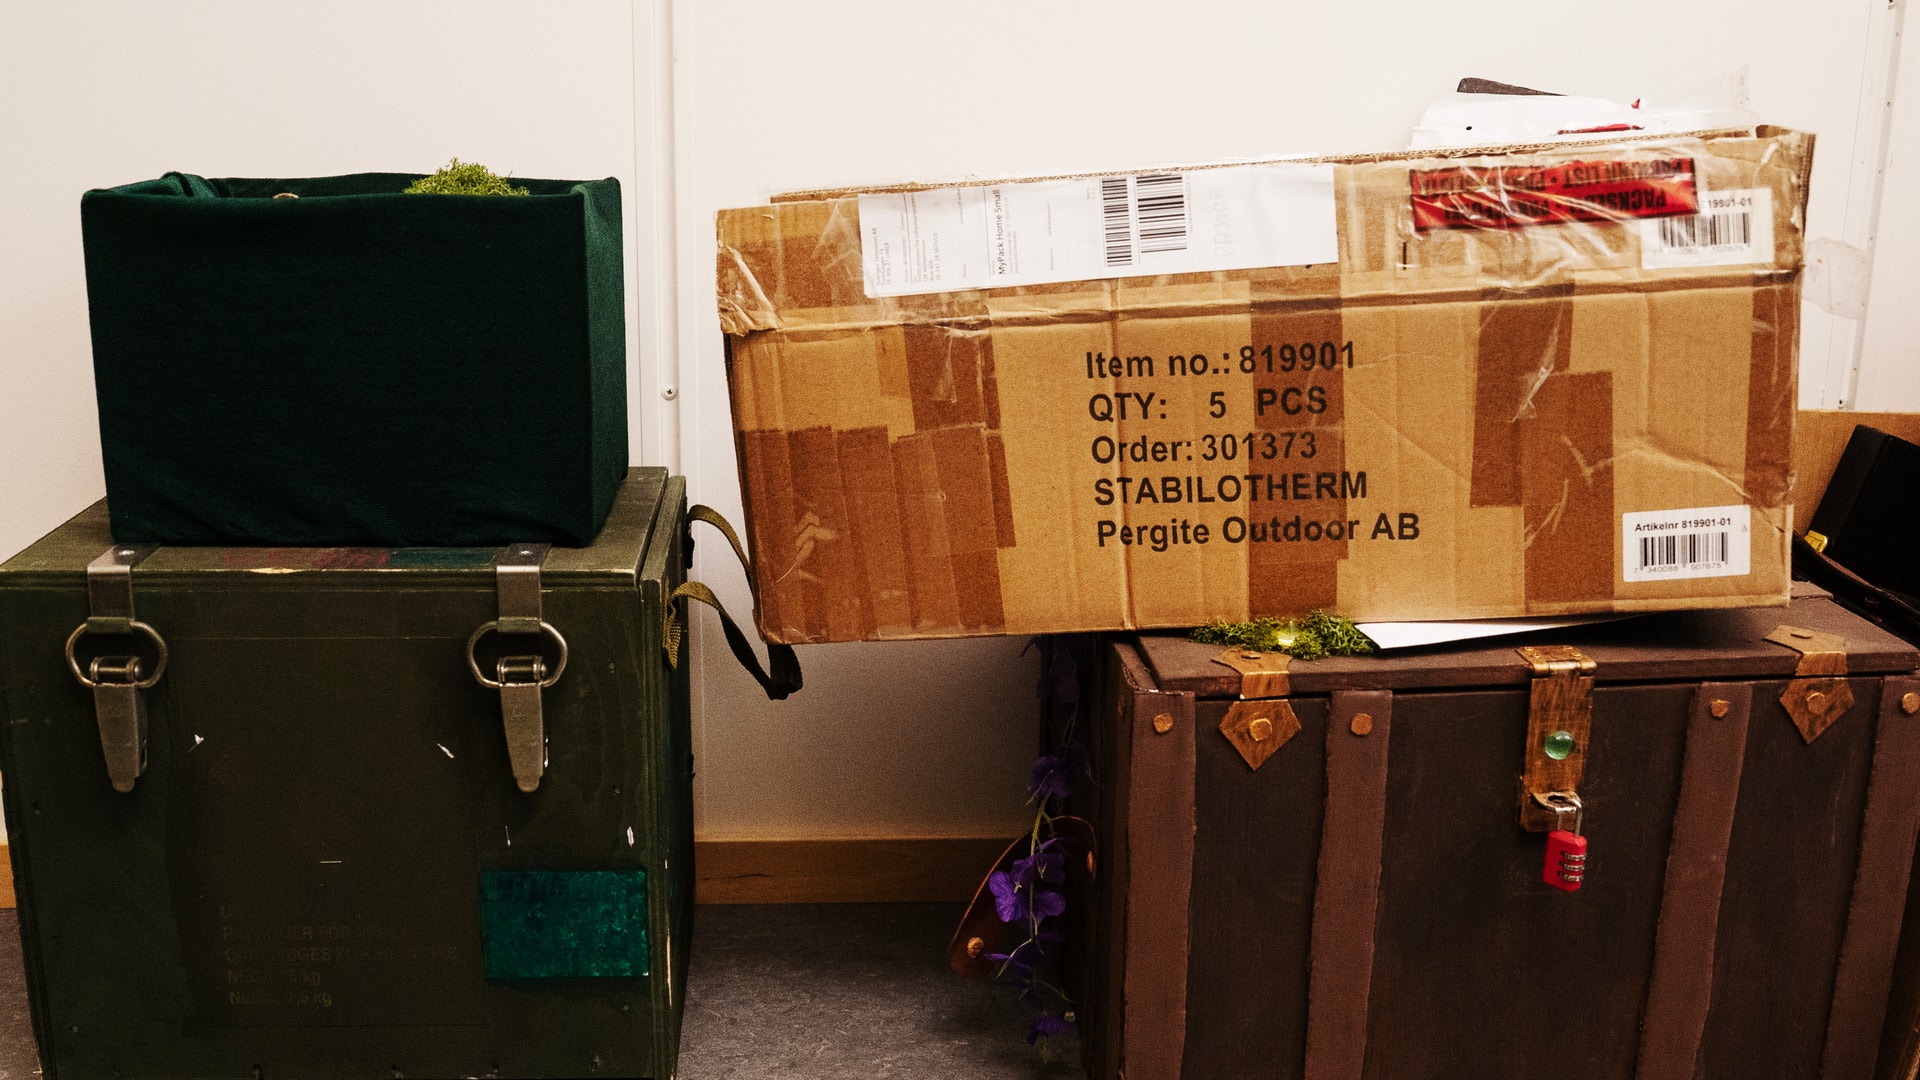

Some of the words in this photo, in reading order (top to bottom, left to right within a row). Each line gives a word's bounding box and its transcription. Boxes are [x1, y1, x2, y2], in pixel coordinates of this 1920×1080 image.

[992, 189, 1002, 213] Small
[995, 214, 1004, 241] Home
[997, 241, 1007, 275] MyPack
[1086, 351, 1154, 378] Item
[1169, 352, 1230, 376] no.:
[1238, 341, 1355, 373] 819901
[1088, 391, 1168, 421] QTY:
[1209, 391, 1227, 419] 5
[1256, 386, 1328, 416] PCS
[1091, 435, 1193, 464] Order:
[1201, 431, 1318, 461] 301373
[1094, 471, 1368, 506] STABILOTHERM
[1097, 518, 1211, 553] Pergite
[1222, 514, 1360, 545] Outdoor
[1370, 512, 1421, 541] AB
[1634, 521, 1679, 532] Artikelnr
[1681, 517, 1732, 529] 819901-01
